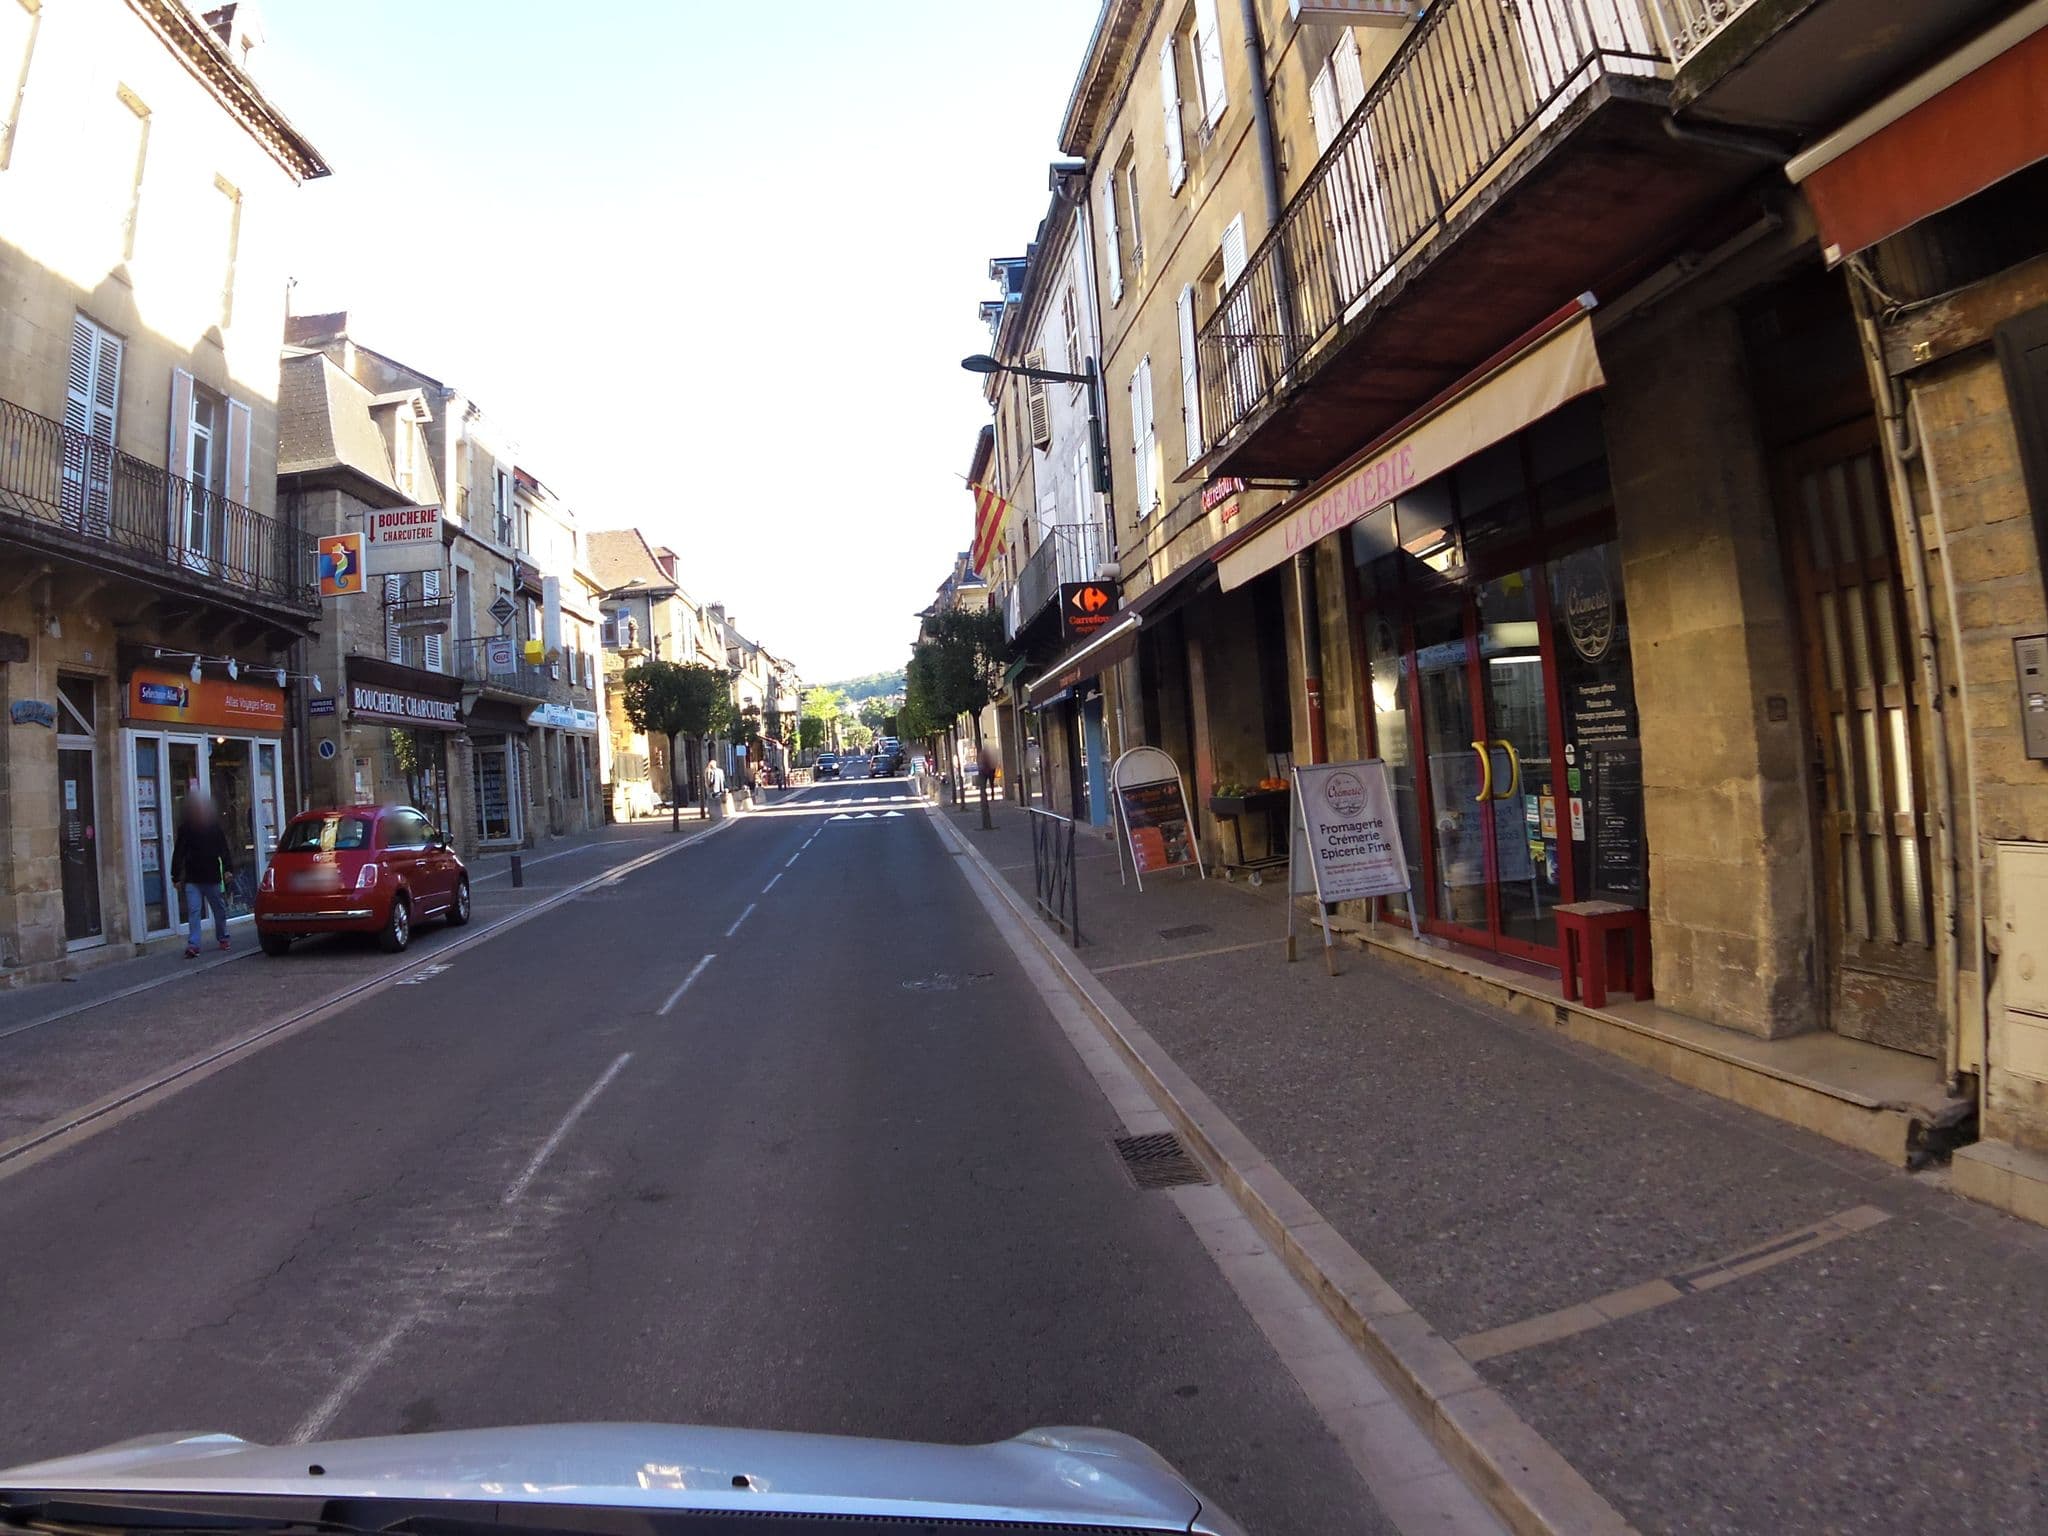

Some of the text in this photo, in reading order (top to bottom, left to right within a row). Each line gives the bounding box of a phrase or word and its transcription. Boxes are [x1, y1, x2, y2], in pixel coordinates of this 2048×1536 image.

[1284, 444, 1416, 550] LA CREMERIE
[378, 508, 438, 528] BOUCHERIE
[354, 687, 457, 721] BOUCHERIE CHARCUTERIE
[1320, 818, 1383, 835] Fromagerie
[1328, 831, 1380, 846] Crémerie
[1320, 842, 1392, 861] Epicerie Fine
